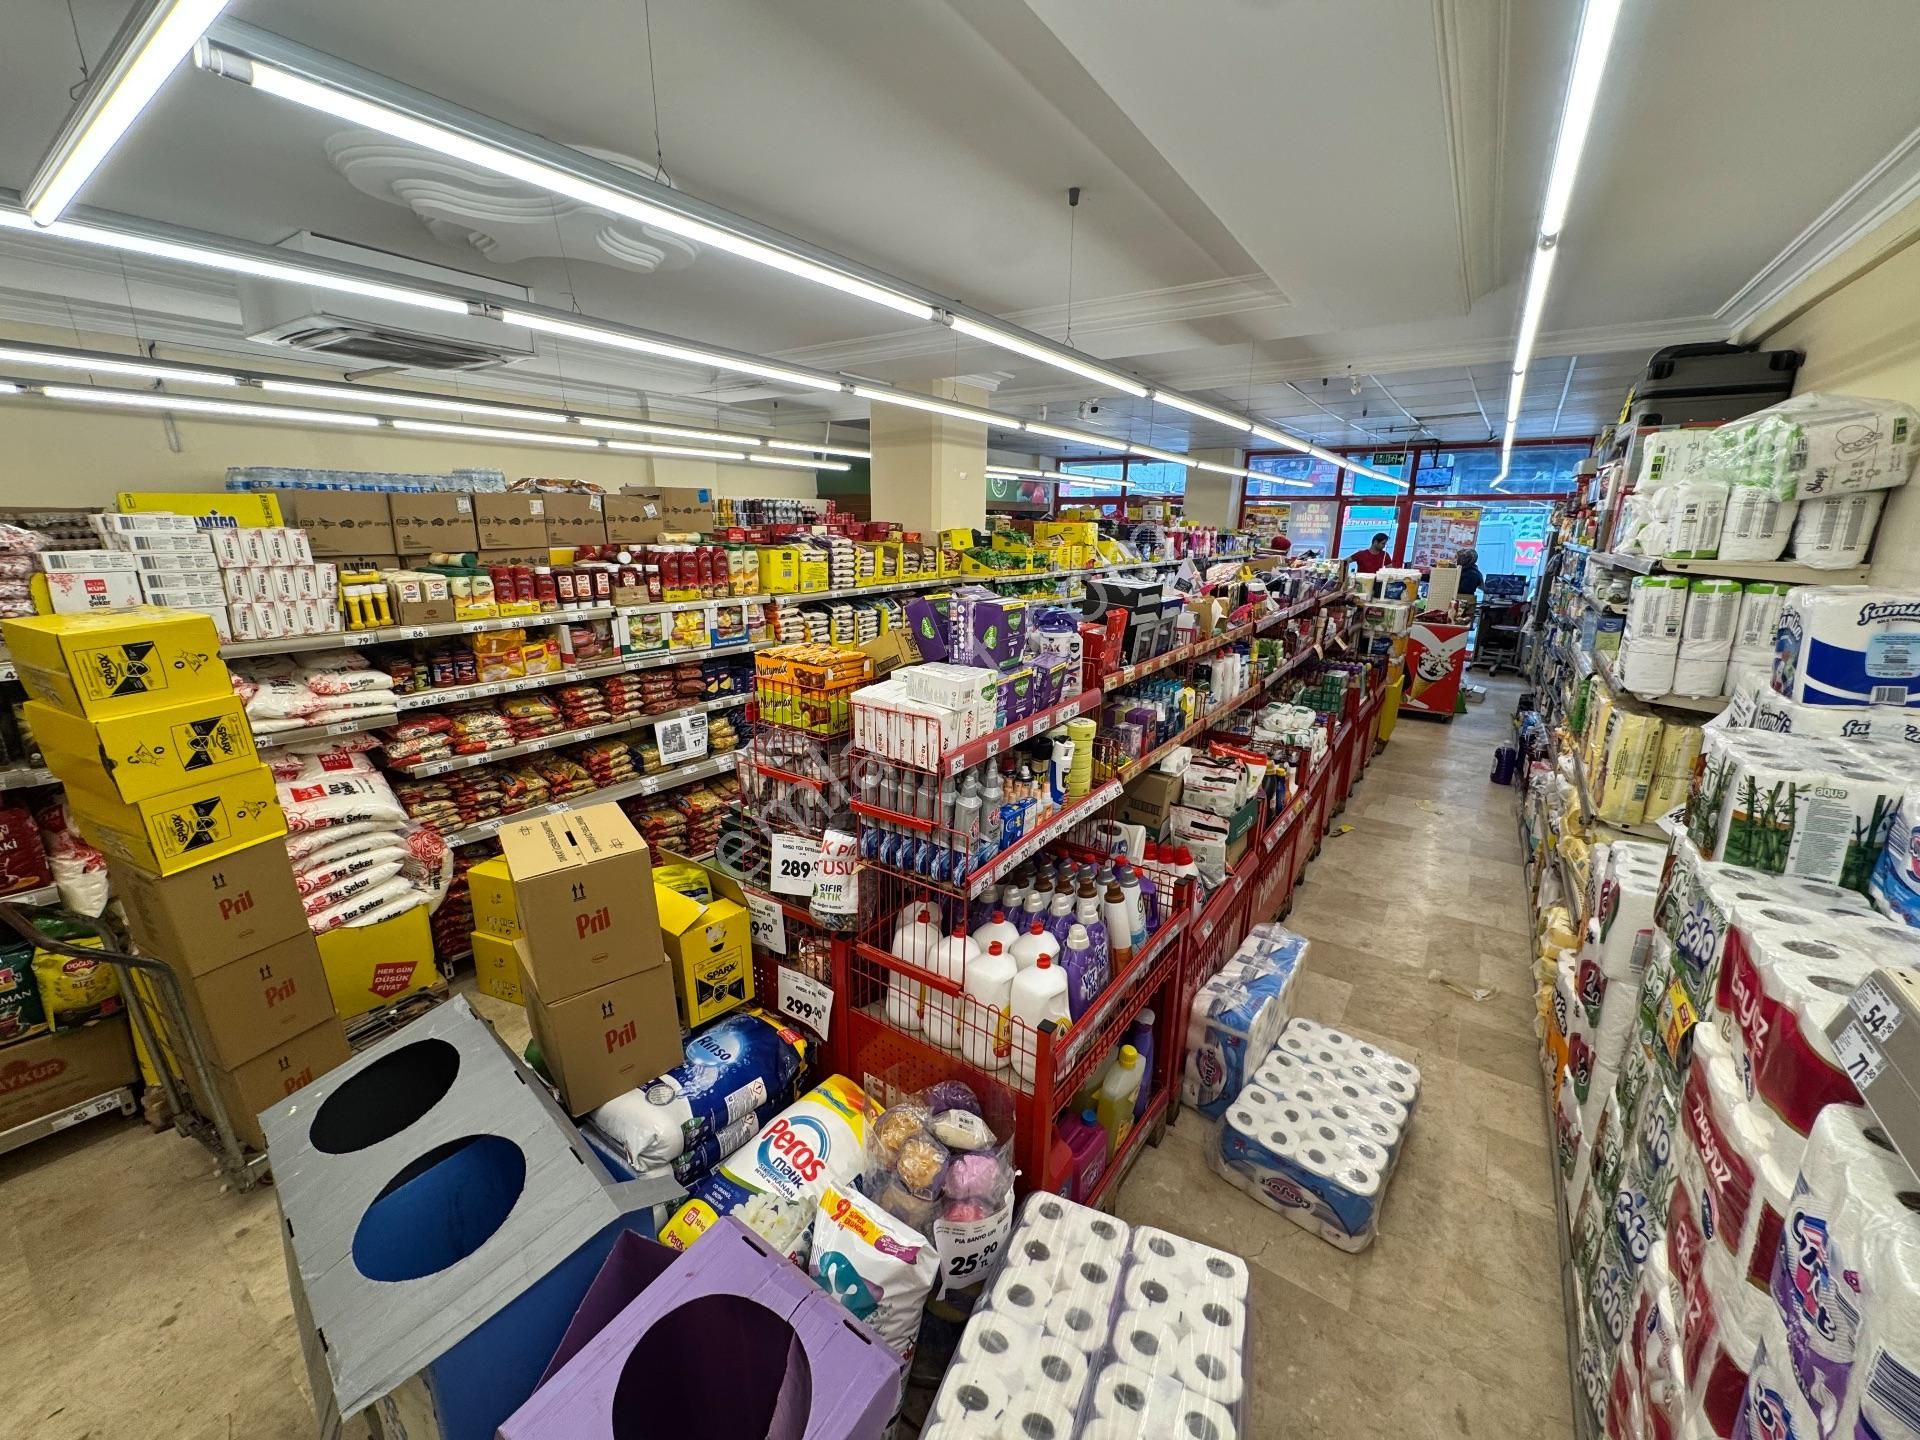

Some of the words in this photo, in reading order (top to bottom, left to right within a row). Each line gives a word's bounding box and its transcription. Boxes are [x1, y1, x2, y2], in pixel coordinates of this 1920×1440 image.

[97, 652, 118, 689] SPARX
[757, 662, 788, 678] Nutymax
[216, 723, 234, 756] SPARX
[693, 739, 700, 747] 17
[171, 814, 188, 845] SPARX
[329, 816, 345, 826] Toz
[347, 813, 373, 824] Şeker
[331, 868, 347, 880] Toz
[348, 858, 374, 873] Şeker
[326, 888, 342, 902] Toz
[344, 878, 370, 894] Şeker
[820, 884, 842, 893] SIFIR
[820, 892, 842, 902] ATIK
[218, 890, 254, 922] Pril
[342, 908, 358, 921] Toz
[358, 897, 384, 914] Şeker
[576, 906, 612, 940] Pril
[374, 974, 410, 984] DÜŞÜK
[396, 966, 413, 974] GÜN
[704, 960, 738, 982] SPARX
[264, 978, 296, 1008] Pril
[376, 983, 402, 992] FİYAT
[604, 1020, 638, 1054] Pril
[698, 1034, 732, 1062] Rinso
[762, 1119, 826, 1182] Peros
[772, 1156, 804, 1190] matik
[830, 1198, 852, 1222] 9
[850, 1210, 867, 1227] SÜPER
[844, 1217, 868, 1239] EKONOMİ
[967, 1233, 987, 1244] BANYO
